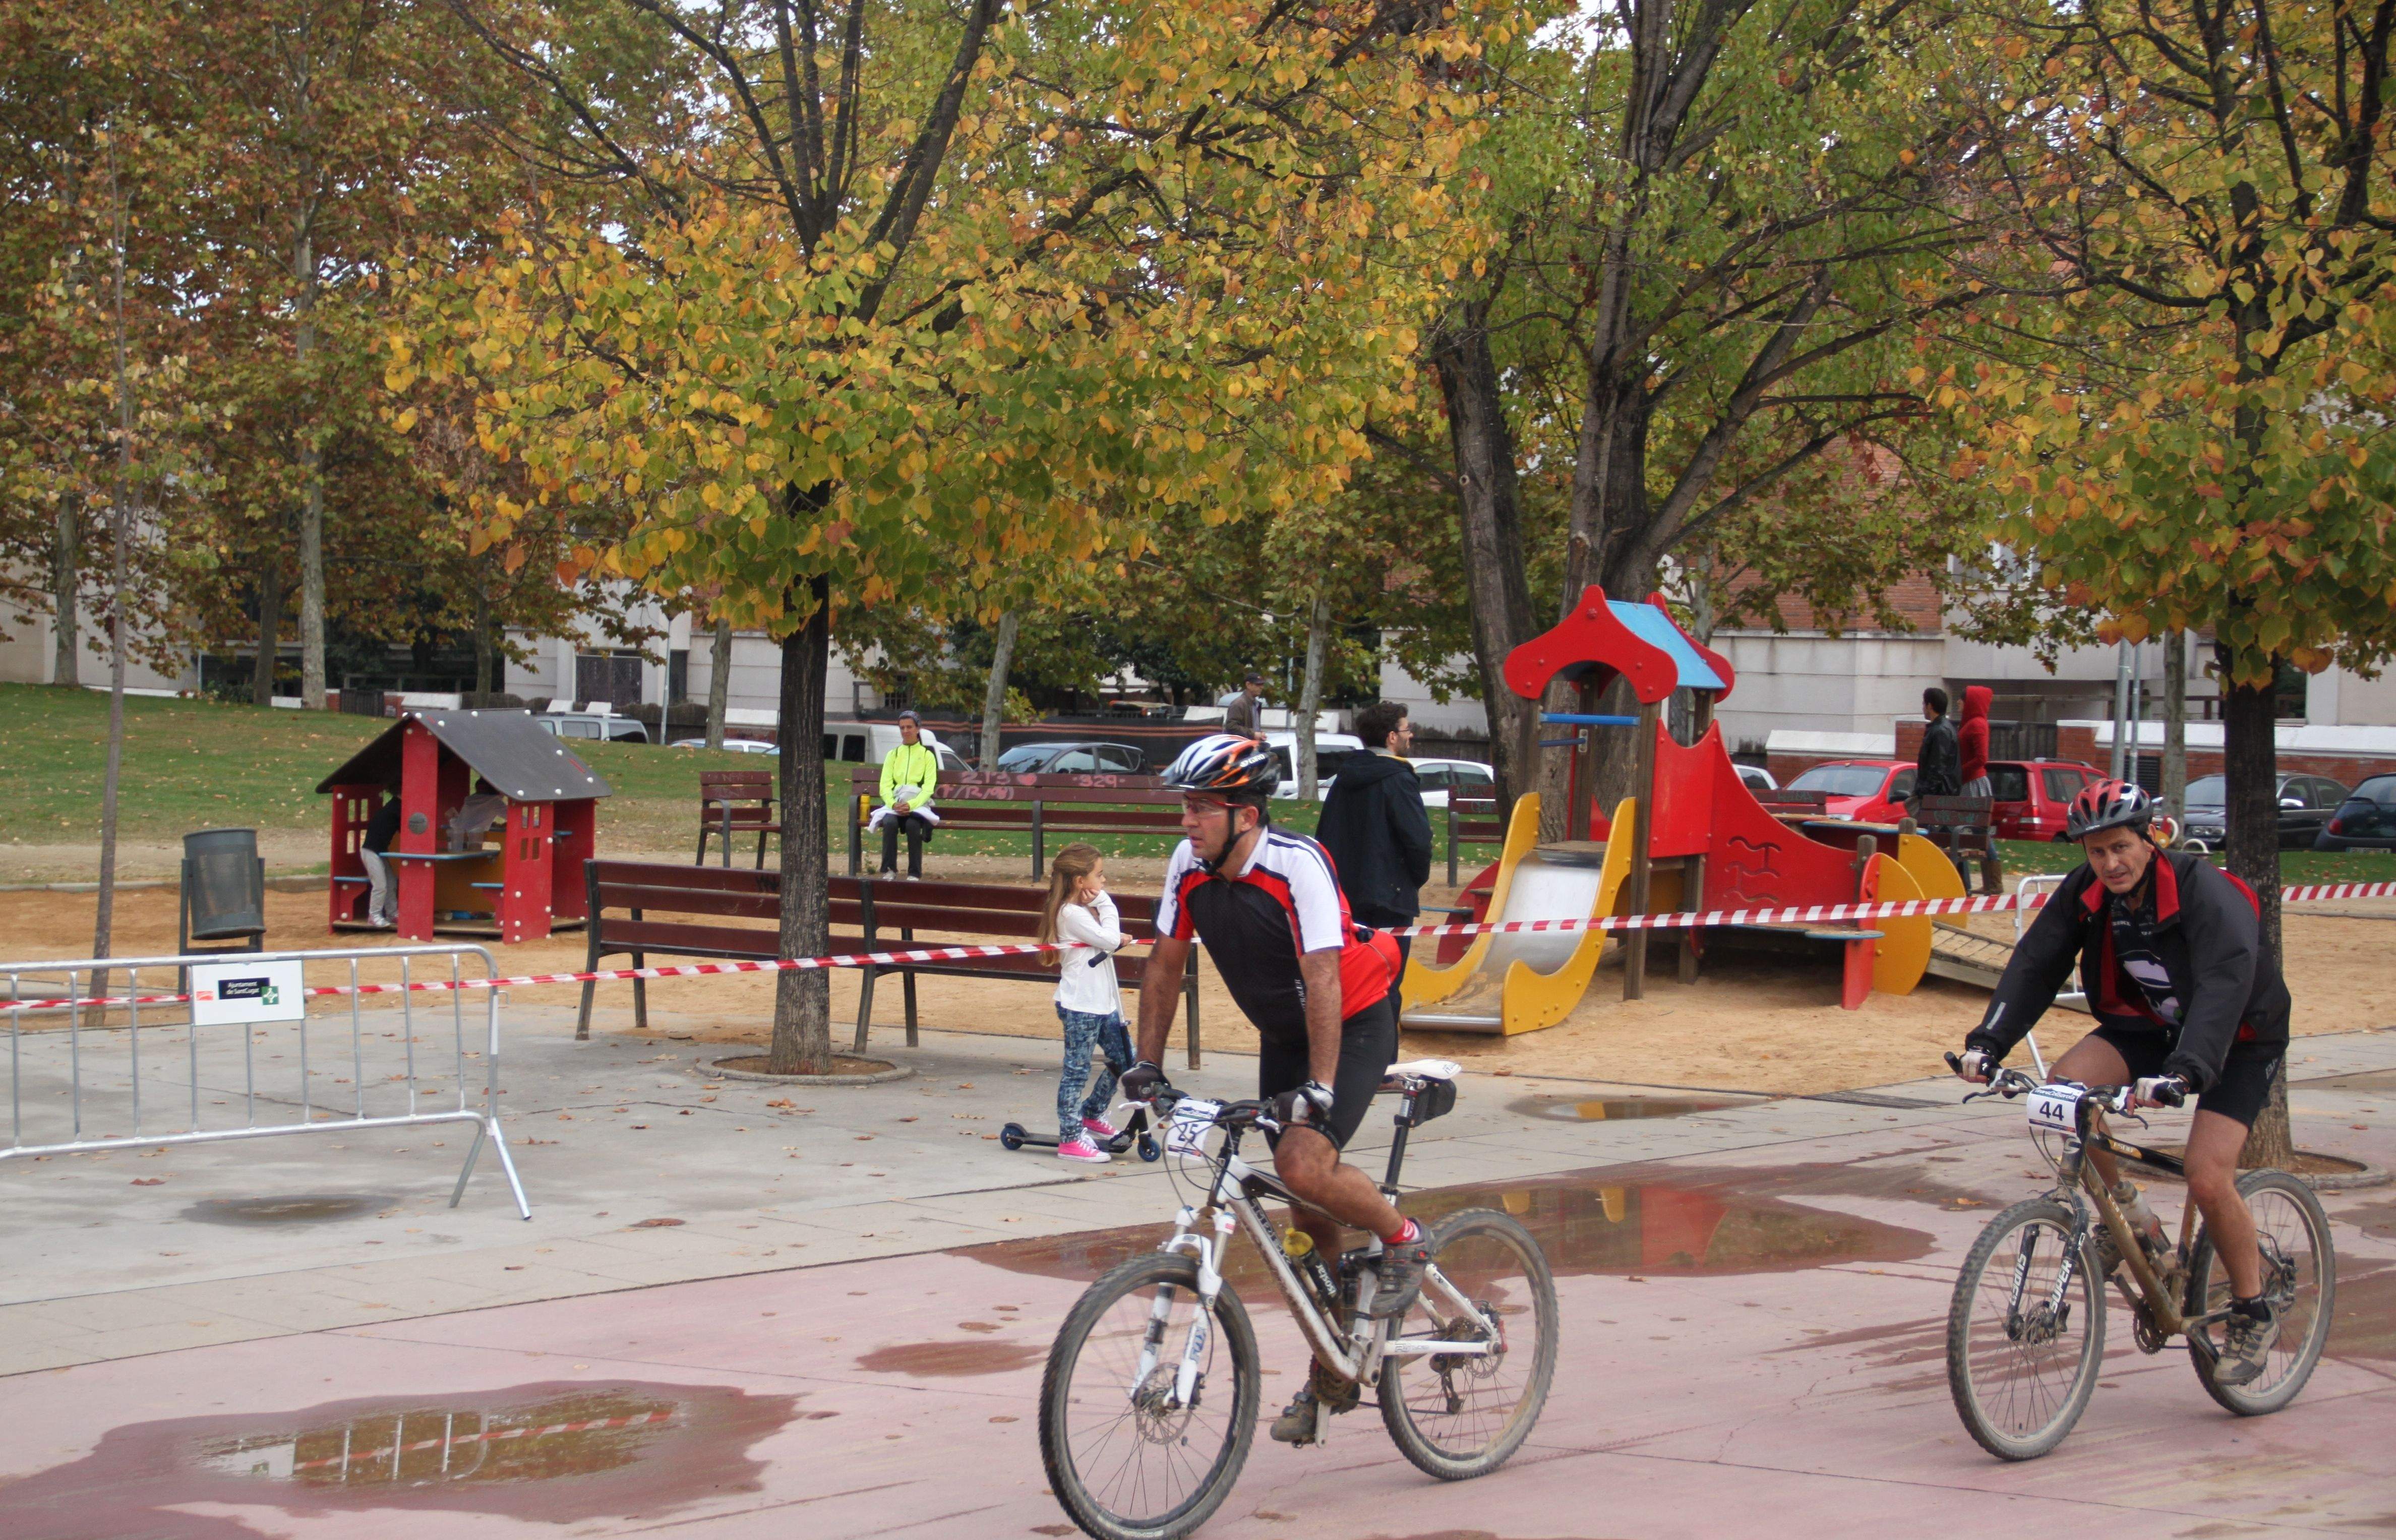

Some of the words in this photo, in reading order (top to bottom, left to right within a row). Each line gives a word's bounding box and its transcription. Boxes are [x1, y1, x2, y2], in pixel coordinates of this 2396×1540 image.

[2040, 1100, 2064, 1122] 44
[1178, 1122, 1199, 1143] 25
[2049, 1259, 2073, 1314] SUPER
